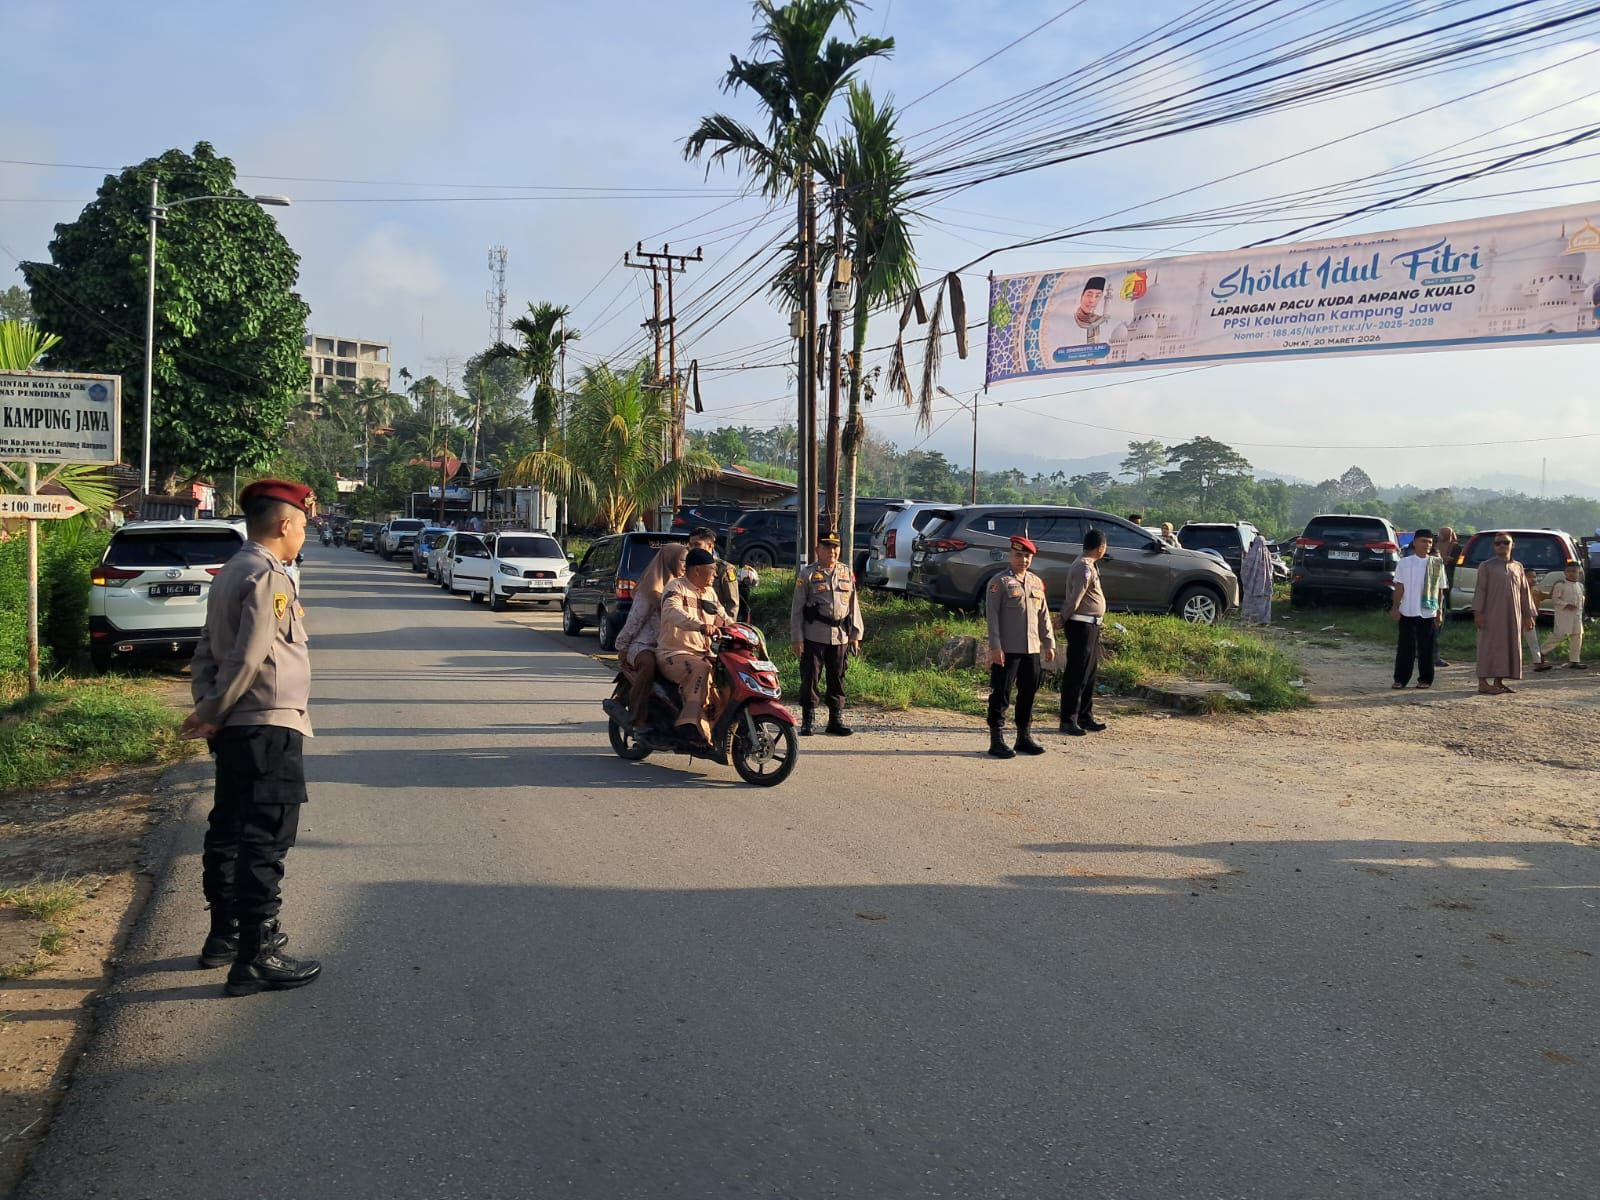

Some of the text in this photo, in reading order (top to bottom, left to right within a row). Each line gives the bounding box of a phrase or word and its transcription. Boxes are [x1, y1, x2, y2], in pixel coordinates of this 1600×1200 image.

[1391, 236, 1484, 280] Fitri
[1211, 284, 1475, 317] LAPANGAN PACU KUDA AMPANG KUALO
[1223, 302, 1453, 329] PPSI Kelurahan Kampung Jawa
[1234, 332, 1264, 341] Nomor
[1328, 337, 1354, 345] MARET
[1358, 335, 1382, 343] 2026
[32, 381, 55, 390] KOTA
[58, 382, 86, 391] SOLOK
[18, 389, 71, 399] PENDIDIKAN
[3, 406, 110, 432] KAMPUNG JAWA
[0, 447, 62, 455] KOTA SOLOK
[11, 501, 29, 512] 100
[33, 503, 61, 513] meter
